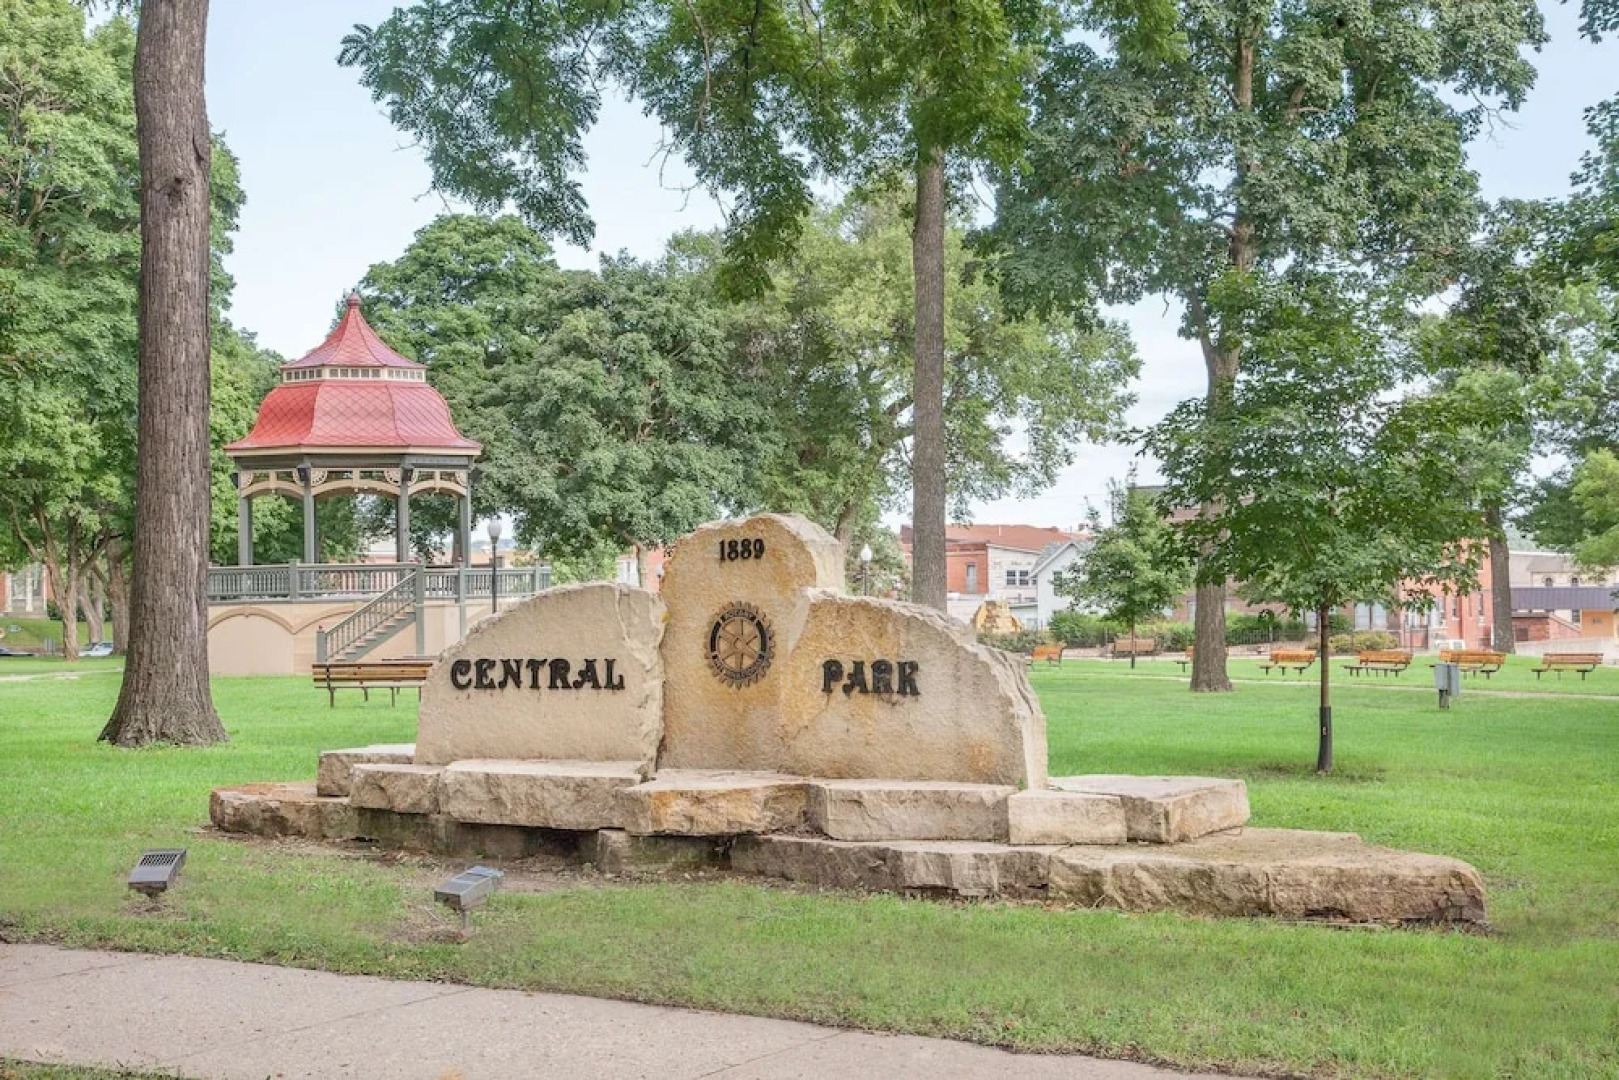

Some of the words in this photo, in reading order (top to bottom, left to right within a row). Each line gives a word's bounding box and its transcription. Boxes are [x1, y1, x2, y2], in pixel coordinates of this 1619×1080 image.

[719, 538, 765, 563] 1889
[450, 658, 625, 691] CENTRAL
[821, 659, 921, 695] PARK
